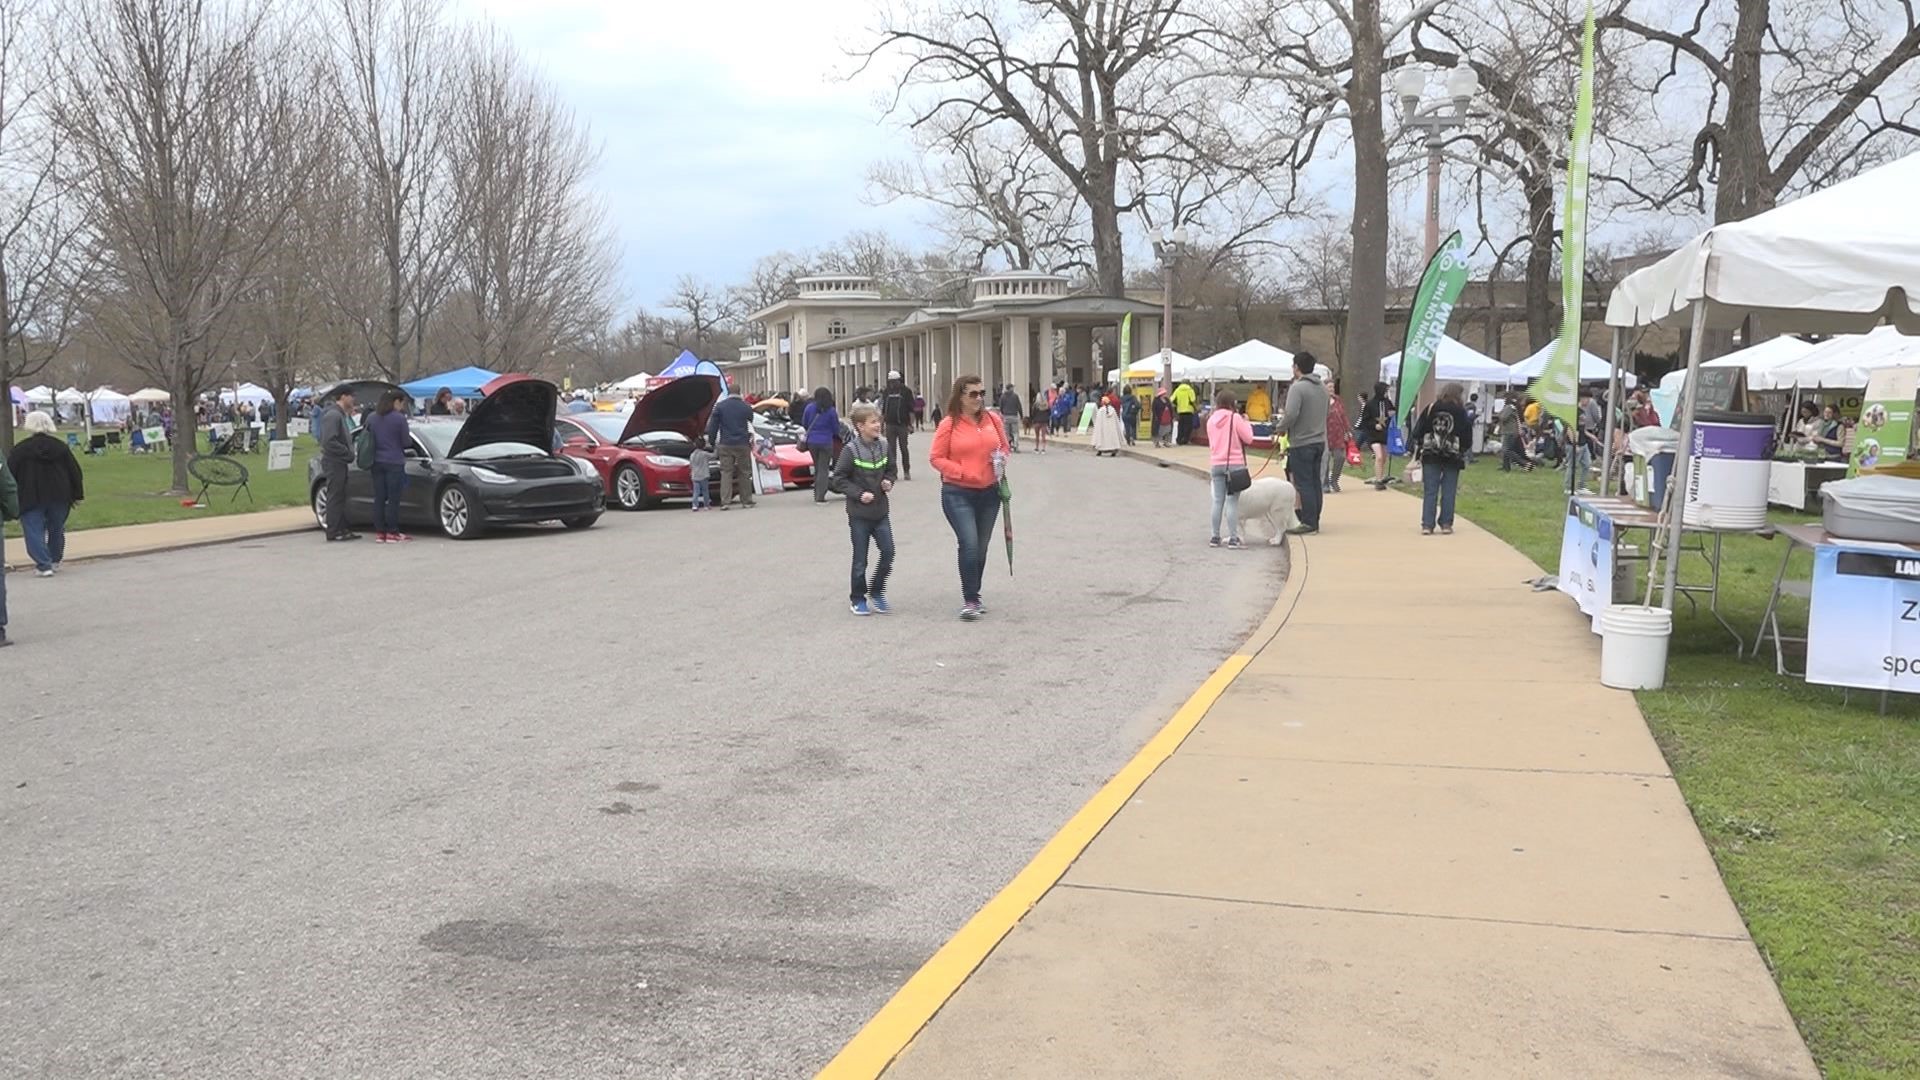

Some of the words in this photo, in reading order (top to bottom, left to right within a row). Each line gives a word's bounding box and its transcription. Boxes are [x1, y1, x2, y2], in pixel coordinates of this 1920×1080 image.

[1406, 320, 1429, 356] DOWN
[1425, 301, 1438, 320] ON
[1432, 280, 1448, 301] THE
[1418, 302, 1454, 362] FARM
[1901, 600, 1920, 621] Z
